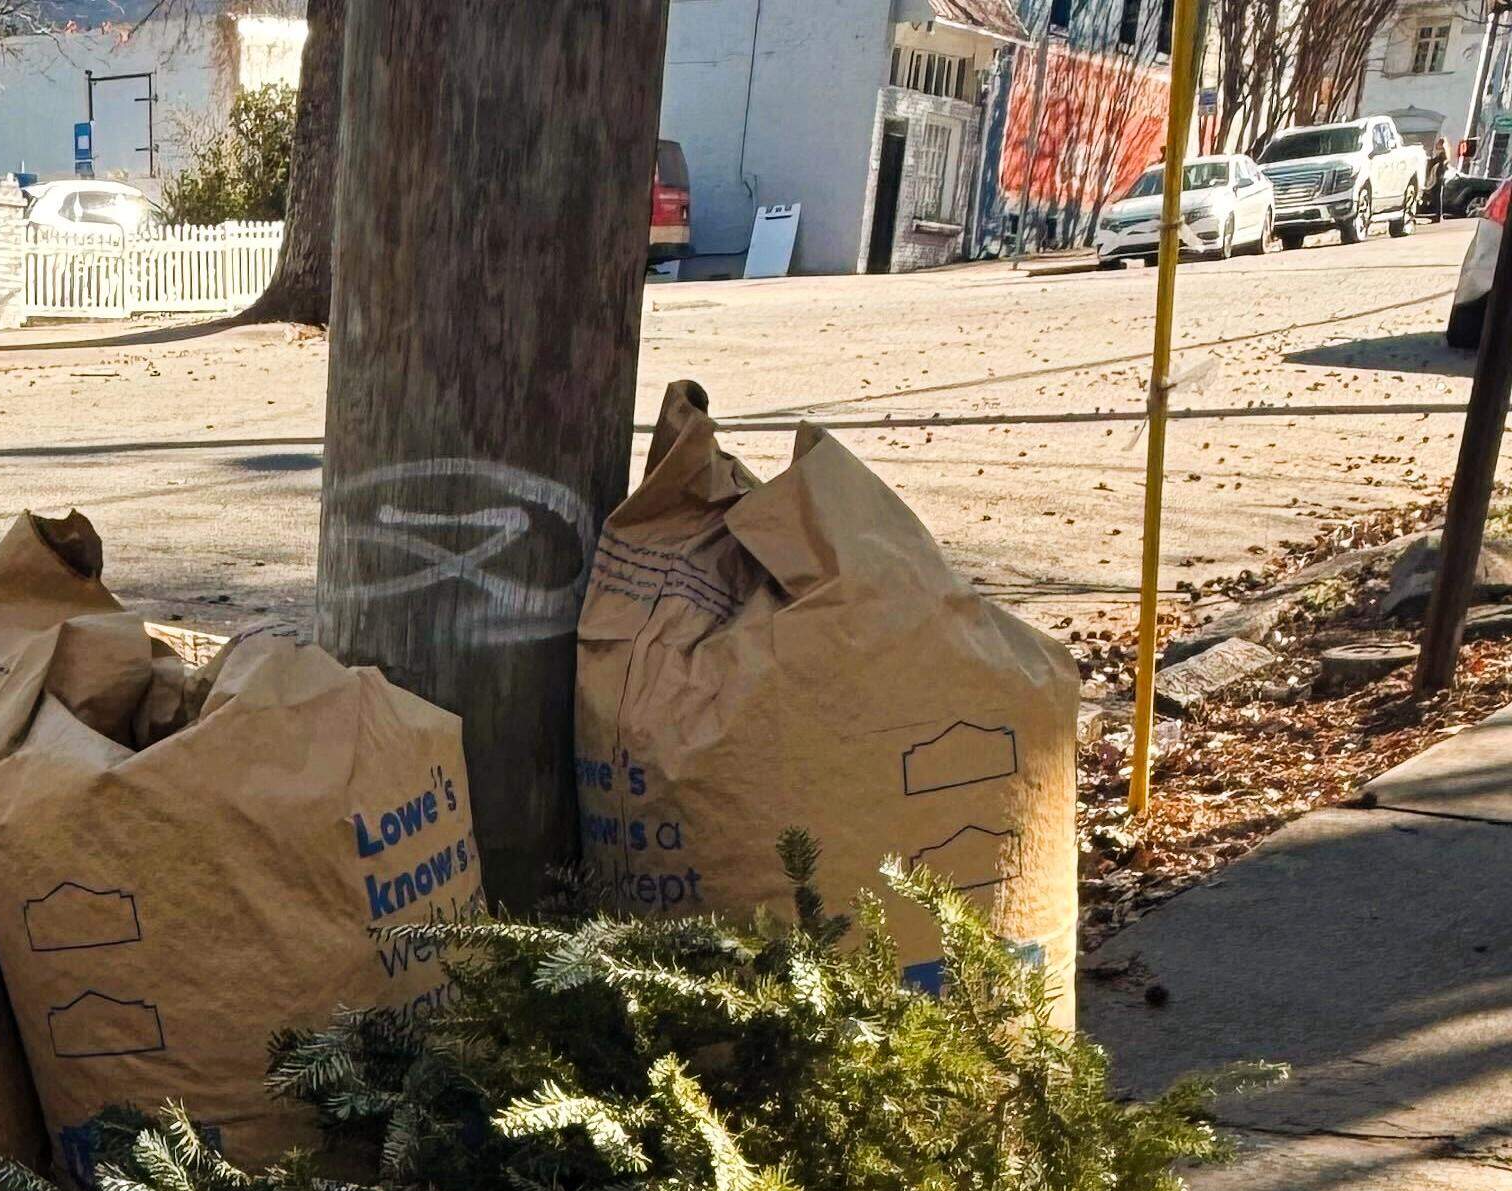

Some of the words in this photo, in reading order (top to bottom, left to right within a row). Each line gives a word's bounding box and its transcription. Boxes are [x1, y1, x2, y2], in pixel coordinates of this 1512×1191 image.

[353, 765, 456, 859] Lowe's
[656, 822, 681, 850] a
[365, 838, 468, 920] knows
